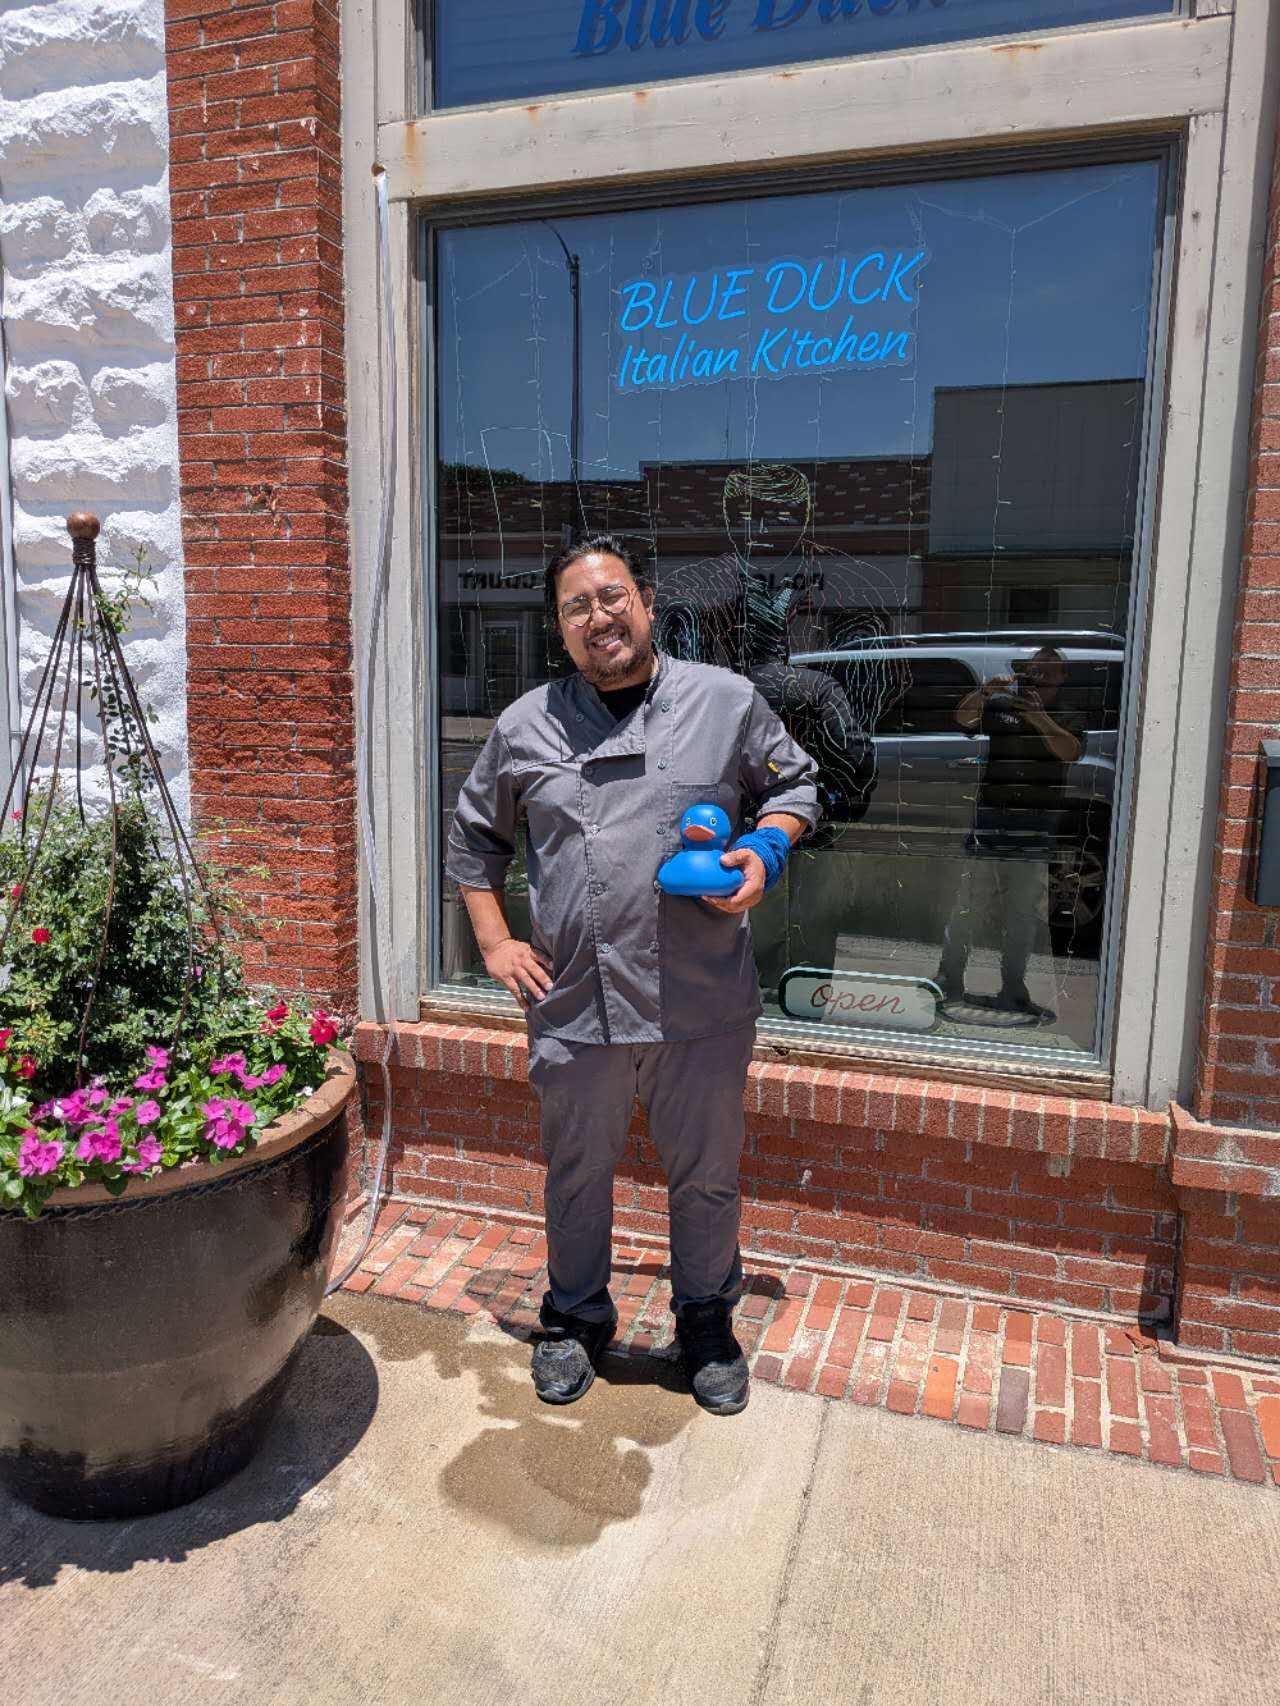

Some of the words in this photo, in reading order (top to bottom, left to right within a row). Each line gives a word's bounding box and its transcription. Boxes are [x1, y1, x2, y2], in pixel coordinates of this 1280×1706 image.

[620, 269, 754, 332] BLUE
[765, 251, 925, 314] DUCK
[618, 332, 740, 388] Italian
[751, 314, 909, 374] Kitchen
